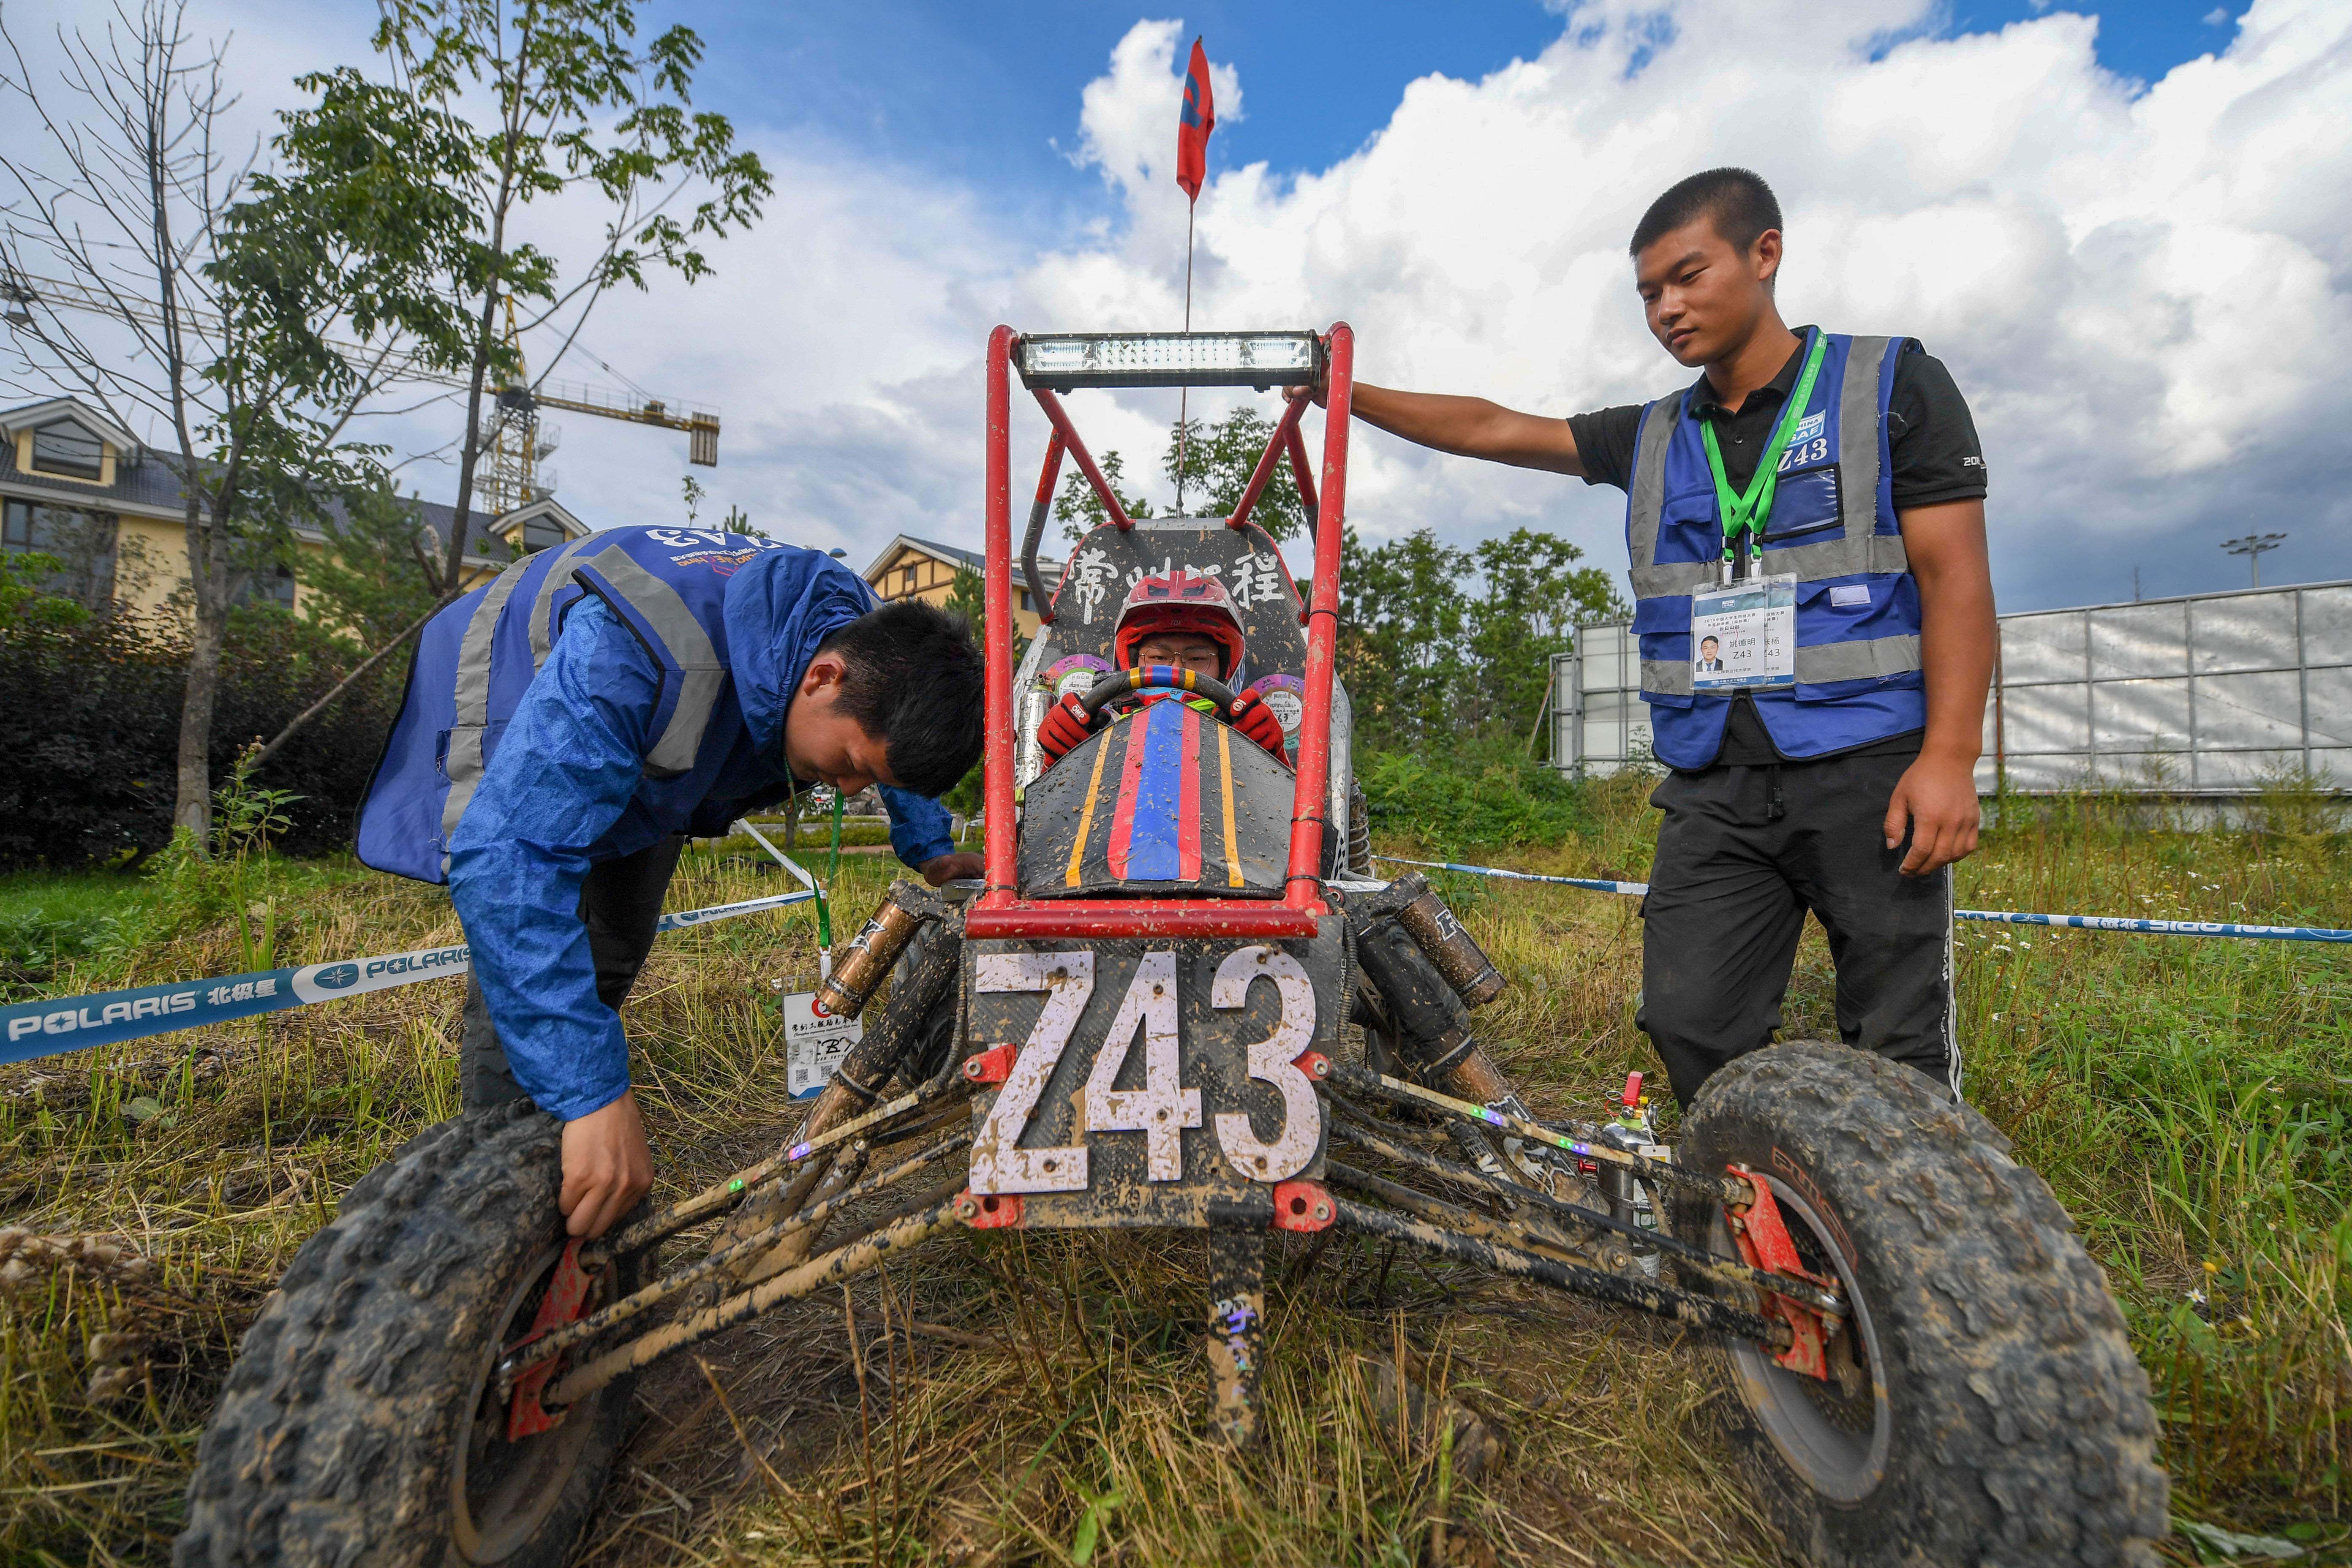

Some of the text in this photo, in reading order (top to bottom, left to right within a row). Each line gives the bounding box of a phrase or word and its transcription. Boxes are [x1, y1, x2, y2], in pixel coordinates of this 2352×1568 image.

[1797, 419, 1818, 428] HINA
[1791, 425, 1820, 442] SAE
[1777, 438, 1827, 473] Z43
[1729, 638, 1756, 648] 姚德明
[1733, 650, 1752, 659] Z43
[1072, 705, 1085, 719] OMP
[366, 947, 470, 978] POLARIS
[8, 978, 278, 1042] POLARIS 北极星
[968, 945, 1322, 1195] Z43
